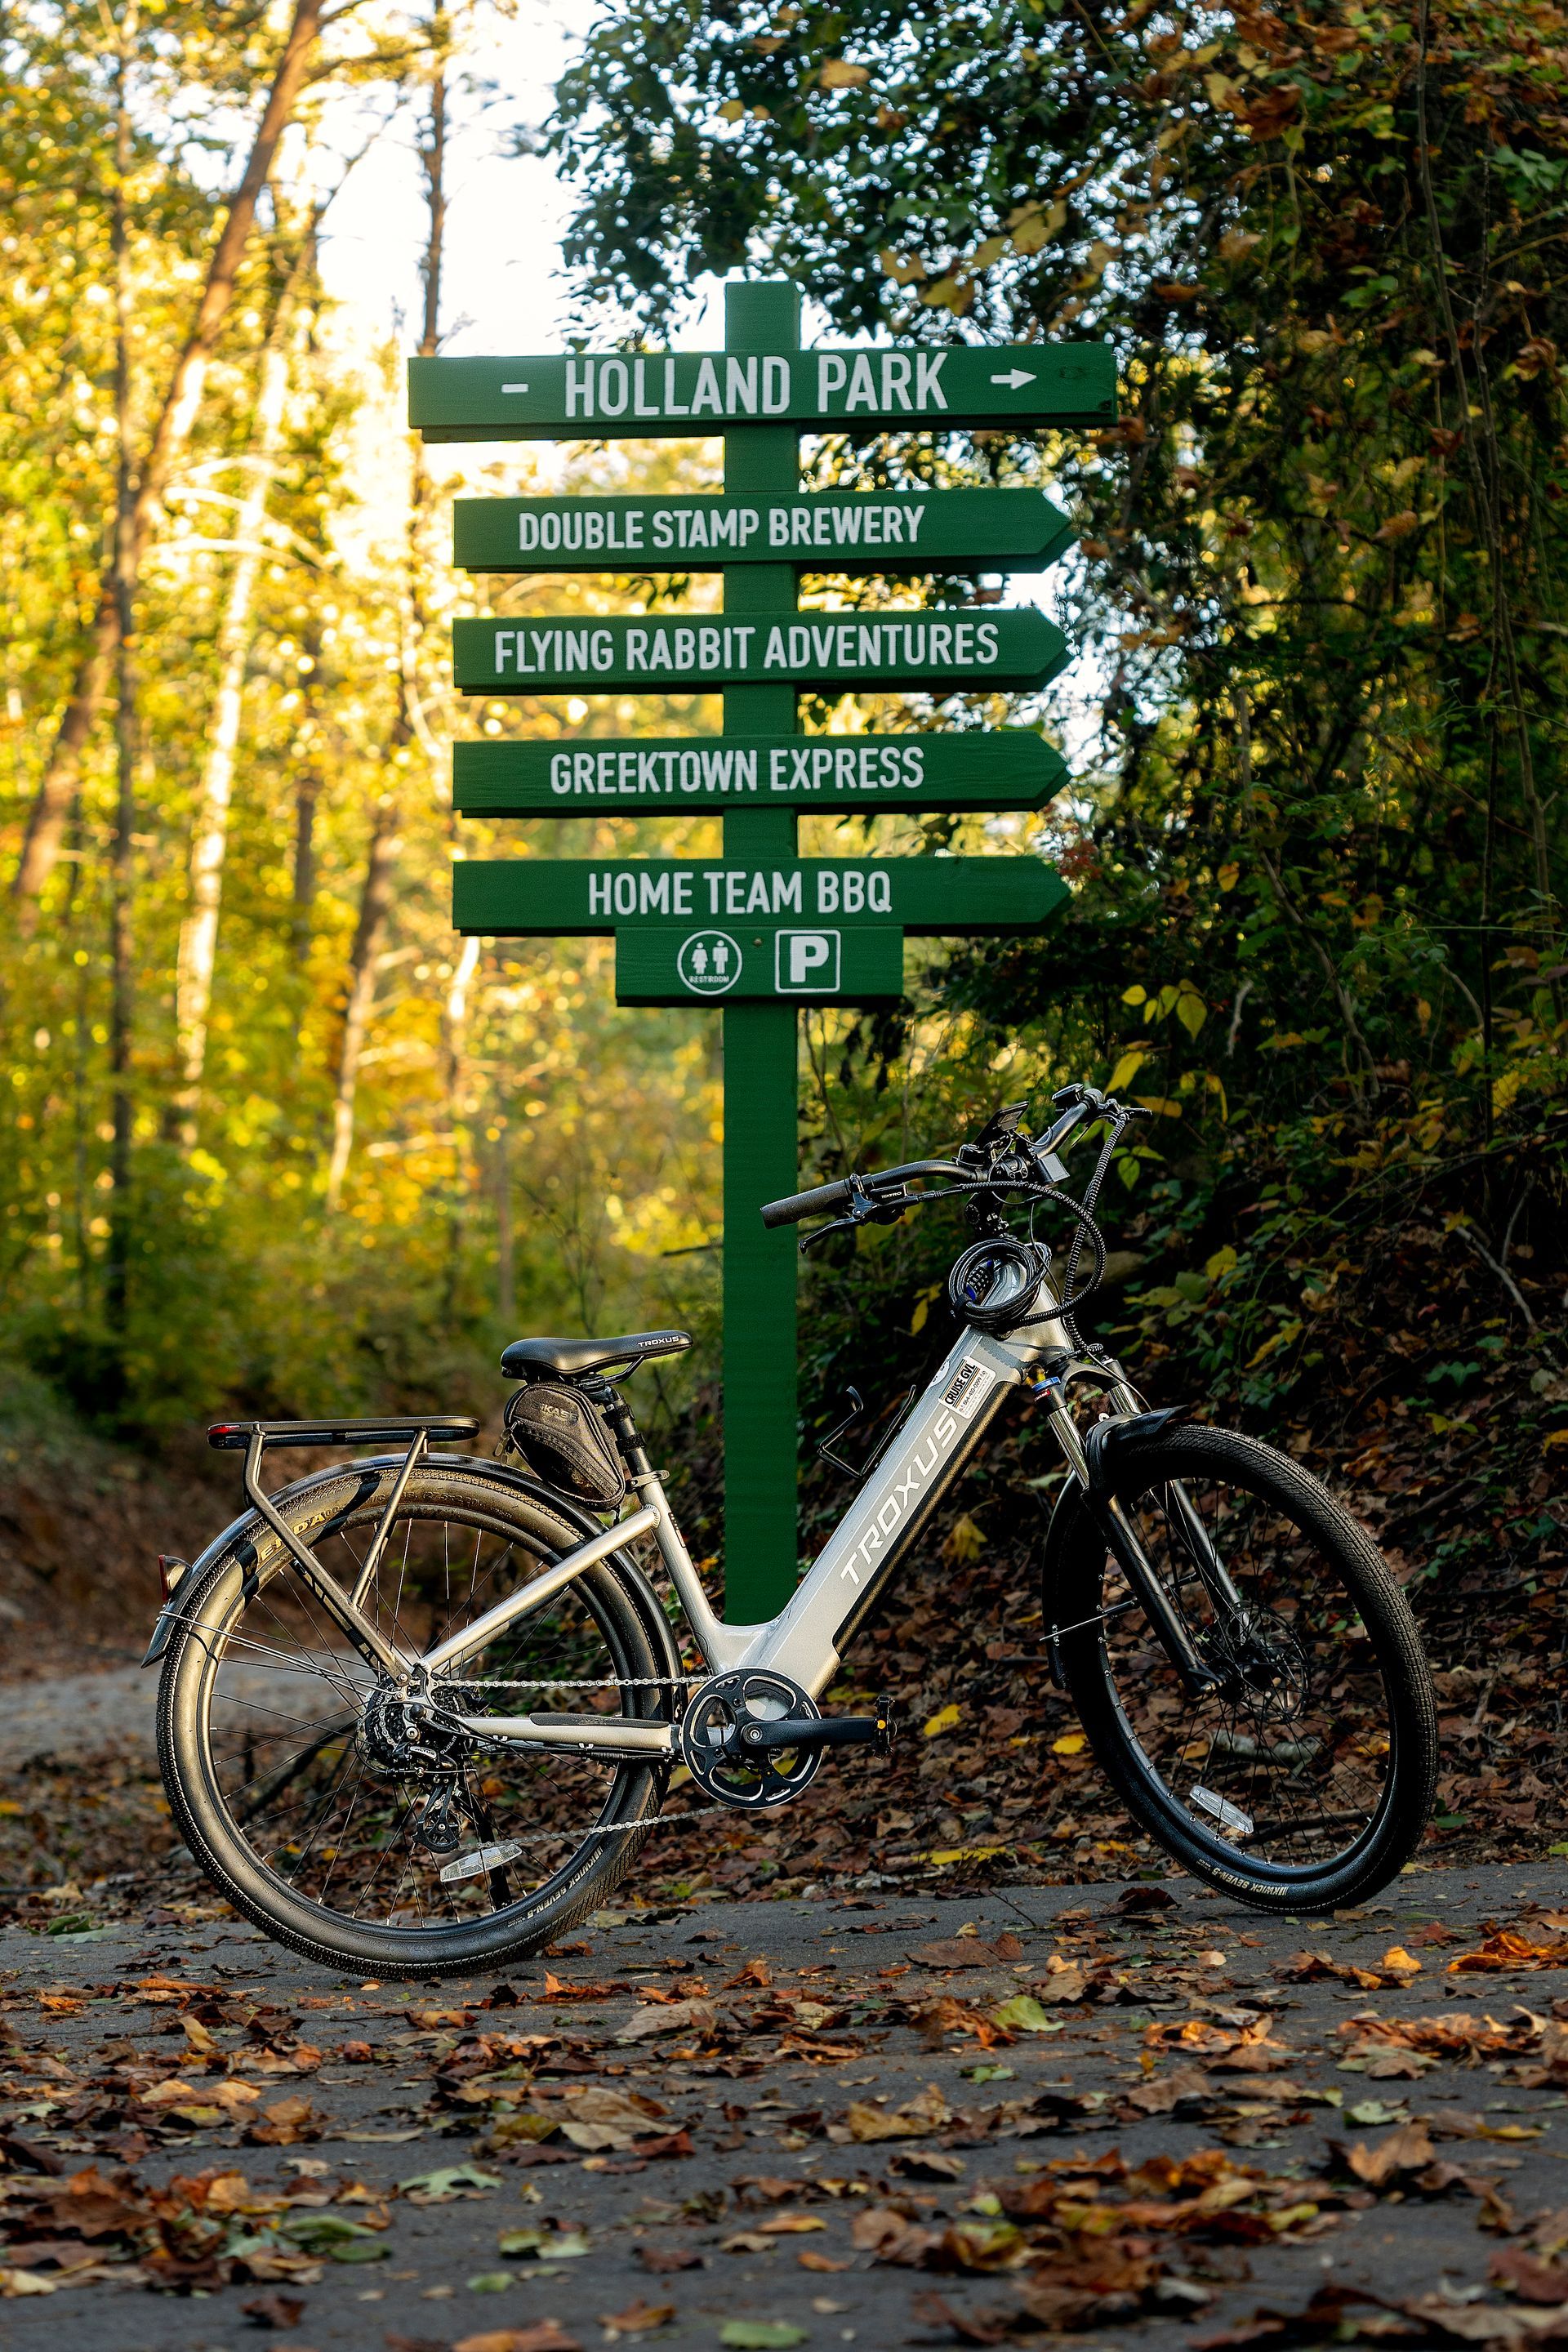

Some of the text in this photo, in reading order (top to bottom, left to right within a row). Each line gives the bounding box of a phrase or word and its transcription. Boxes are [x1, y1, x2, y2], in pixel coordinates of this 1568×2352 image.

[565, 352, 948, 417] HOLLAND PARK
[519, 505, 925, 551] DOUBLE STAMP BREWERY
[495, 623, 999, 674] FLYING RABBIT ADVENTURES
[550, 746, 925, 795] GREEKTOWN EXPRESS
[589, 871, 893, 915] HOME TEAM BBQ
[688, 975, 730, 984] RESTROOM
[790, 935, 830, 983] P
[638, 1336, 679, 1348] TROXUS
[944, 1363, 976, 1405] CRUISE GVL
[840, 1409, 958, 1586] TROXUS
